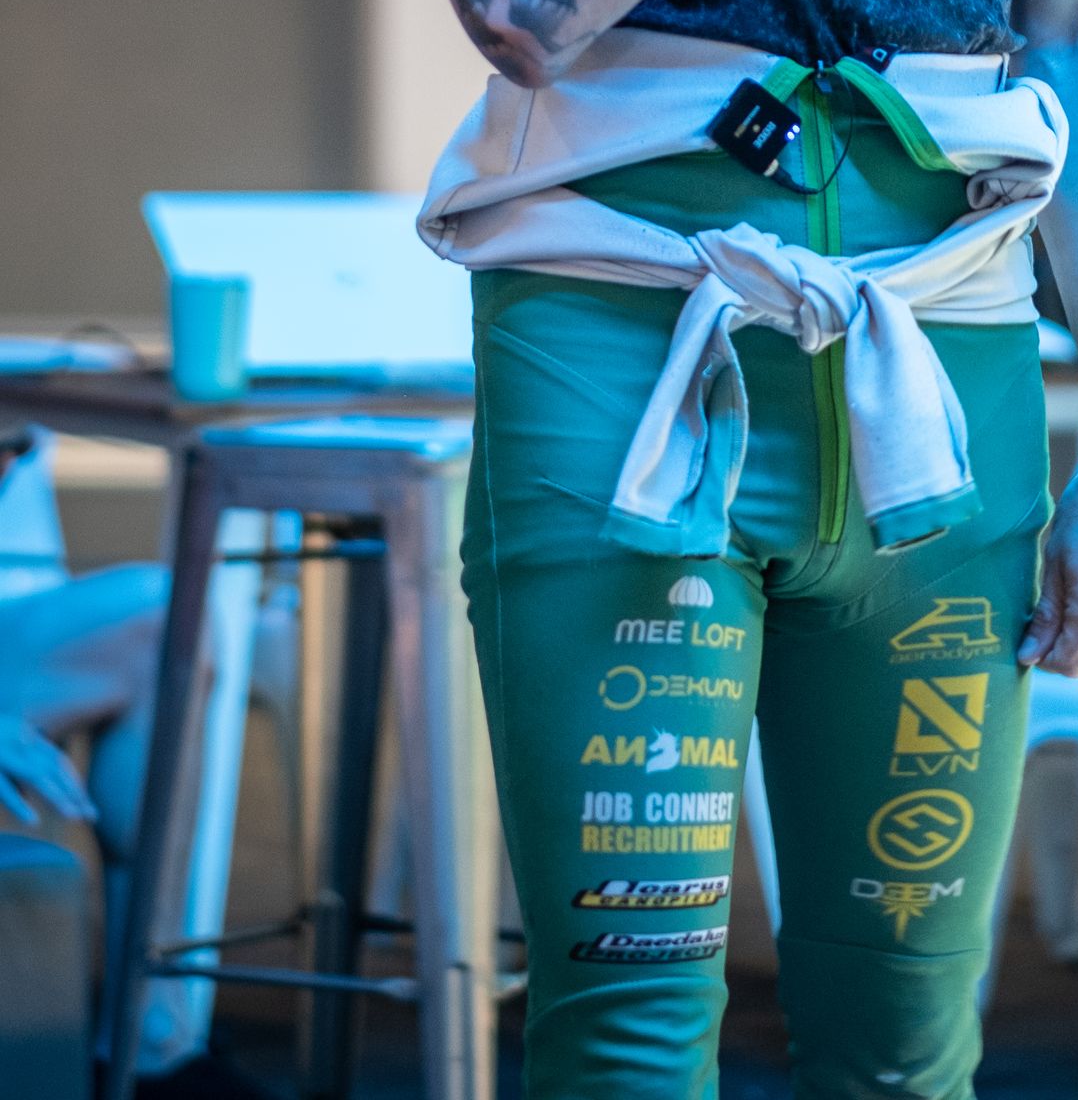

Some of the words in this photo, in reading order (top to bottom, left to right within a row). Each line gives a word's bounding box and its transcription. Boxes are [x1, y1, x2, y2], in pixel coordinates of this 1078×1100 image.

[614, 618, 685, 645] MEE
[690, 622, 746, 651] LOFT
[889, 751, 981, 777] LVN
[582, 791, 633, 822] JOB
[645, 791, 734, 823] CONNECT
[582, 824, 732, 852] RECRUITMENT
